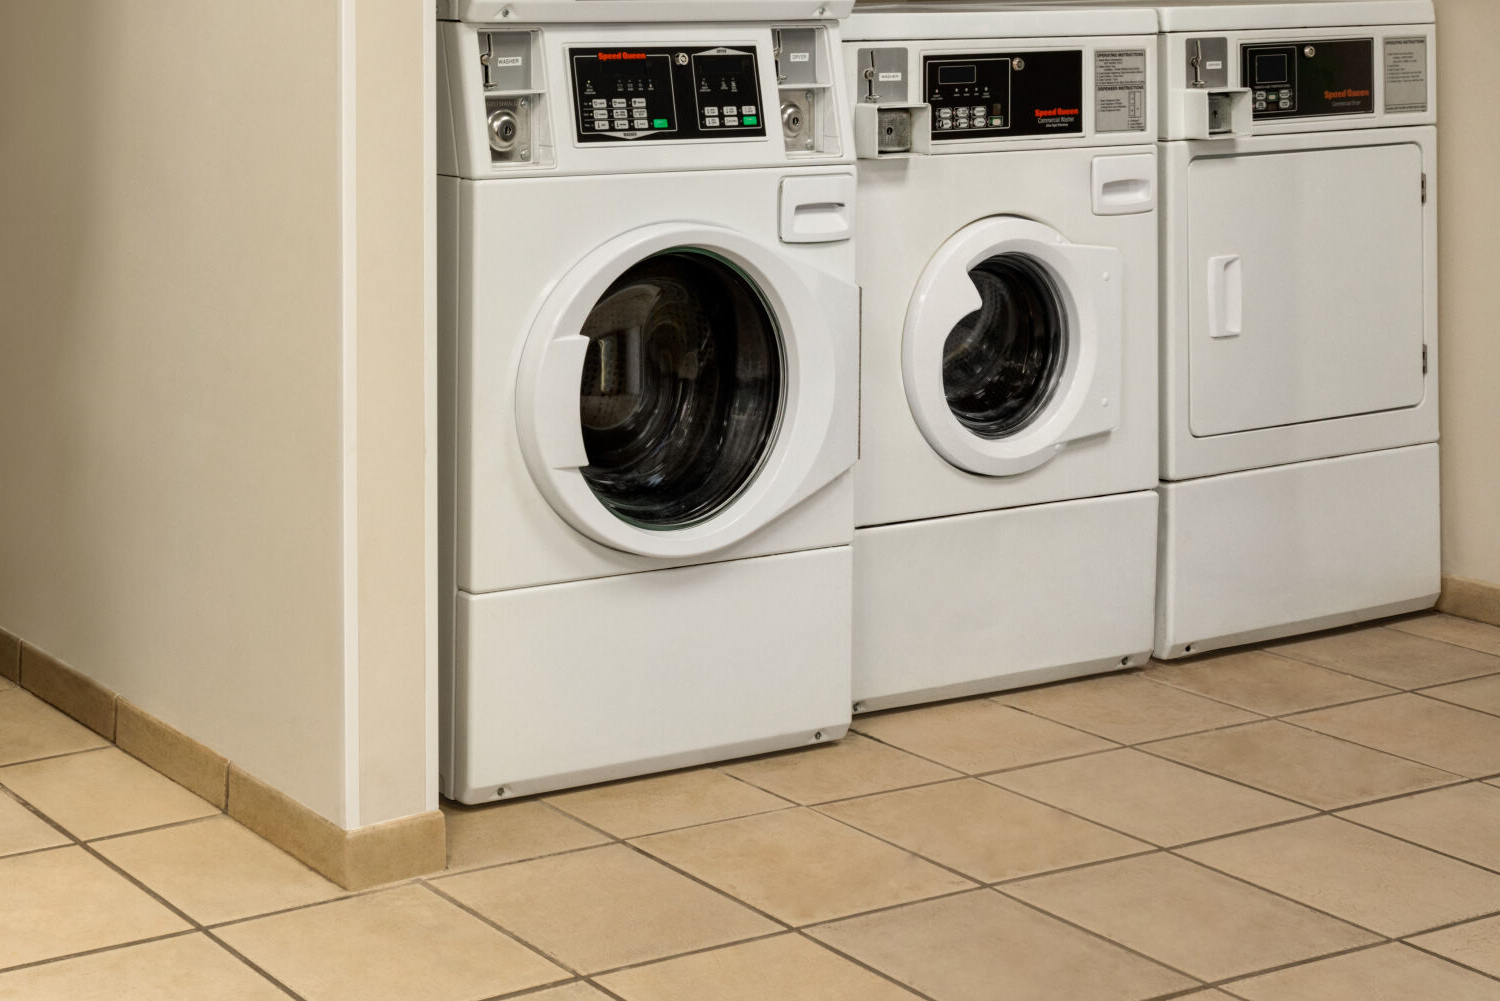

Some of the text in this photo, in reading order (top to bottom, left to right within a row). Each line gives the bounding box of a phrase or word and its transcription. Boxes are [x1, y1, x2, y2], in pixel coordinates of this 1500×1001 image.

[597, 51, 646, 61] Speed Queen
[1323, 89, 1347, 100] Speed
[1034, 107, 1079, 117] Speed Queen
